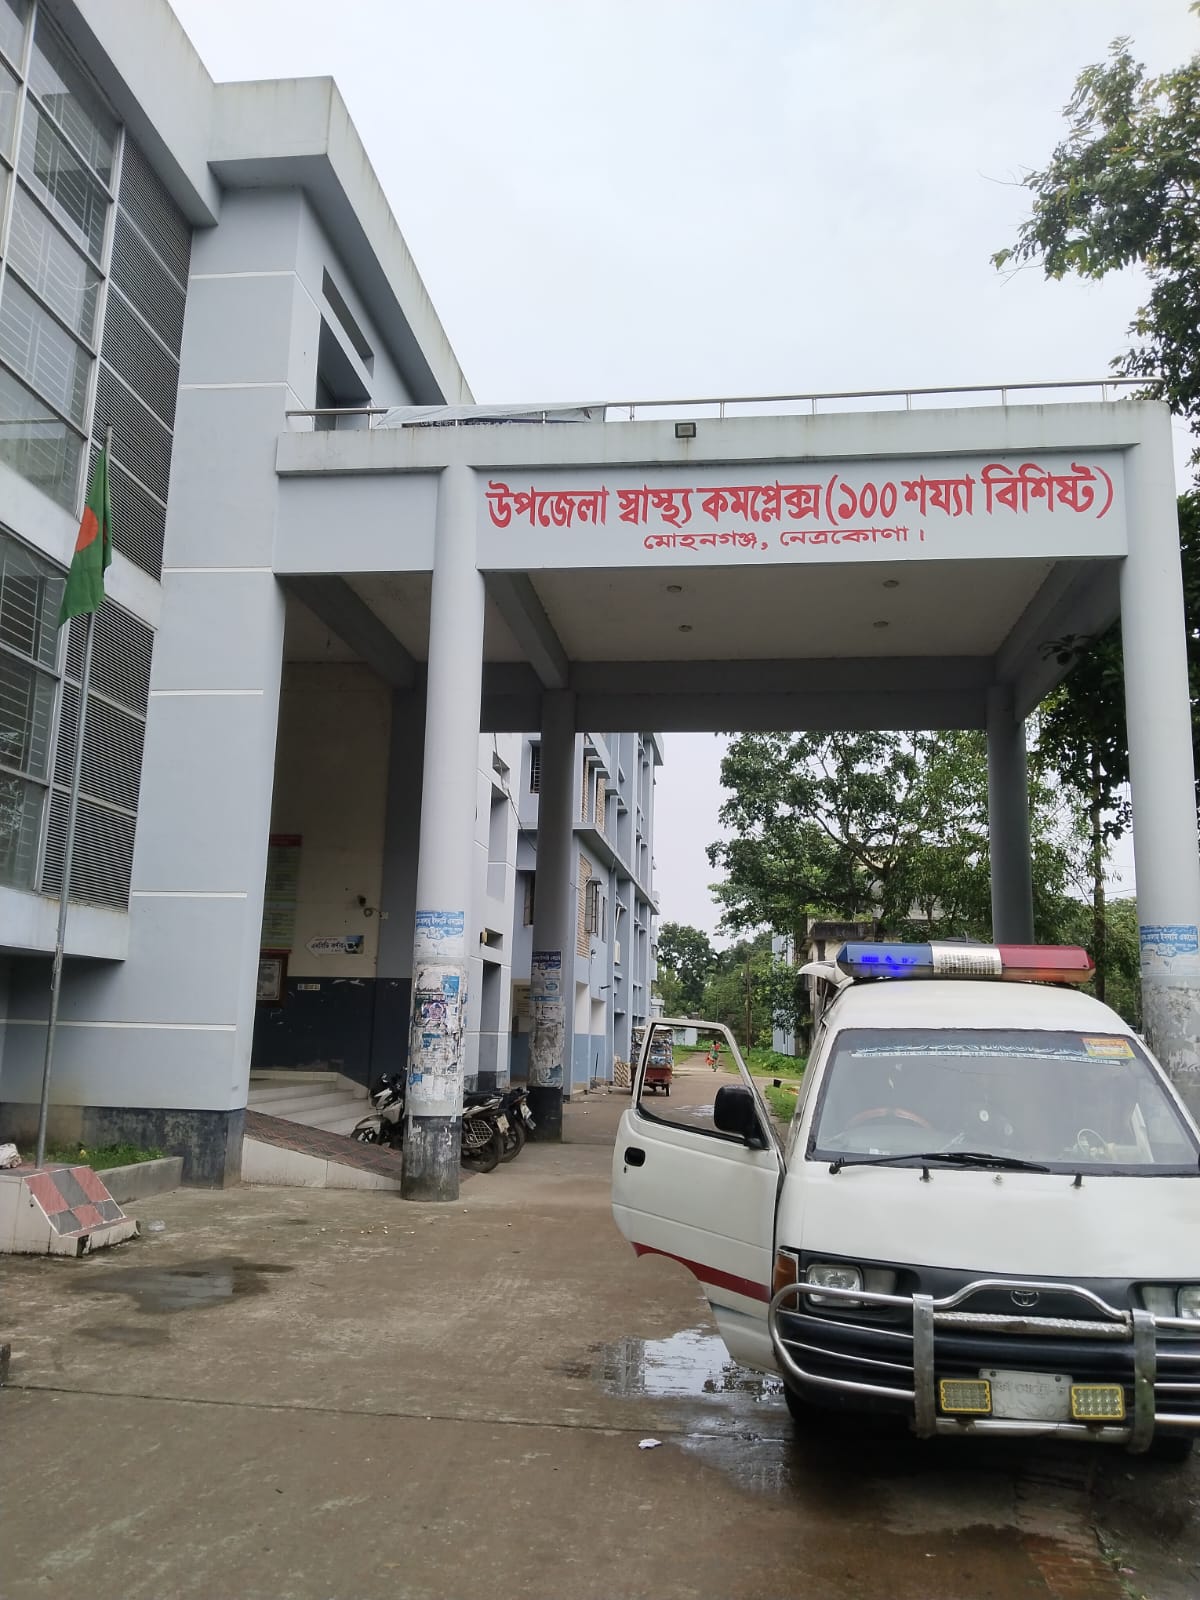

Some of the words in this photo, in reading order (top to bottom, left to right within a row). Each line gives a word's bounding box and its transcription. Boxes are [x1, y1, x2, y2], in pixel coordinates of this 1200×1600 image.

[485, 480, 609, 528] উপজেলা
[617, 484, 693, 528] স্বাস্থ্য
[901, 474, 976, 517] শয্যা
[981, 462, 1113, 519] বিশিষ্ট)
[643, 530, 768, 550] মোহনগঞ্জ,
